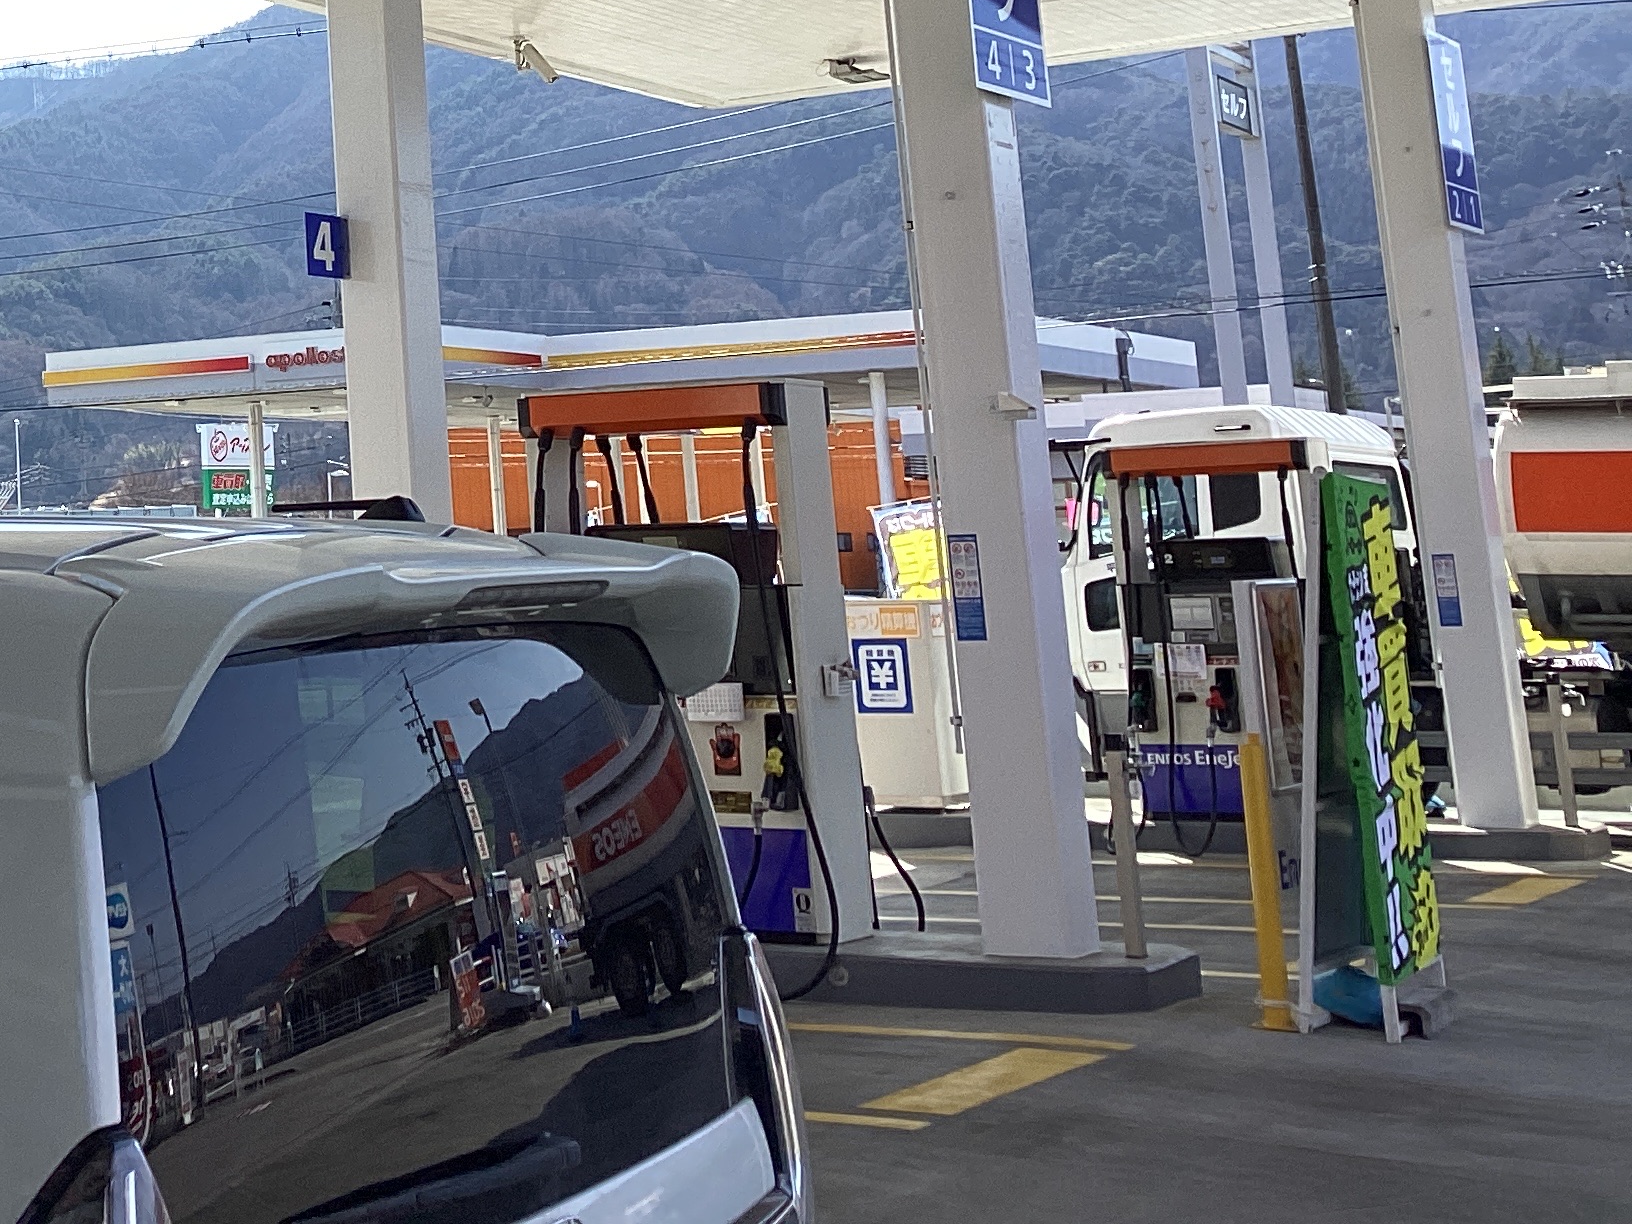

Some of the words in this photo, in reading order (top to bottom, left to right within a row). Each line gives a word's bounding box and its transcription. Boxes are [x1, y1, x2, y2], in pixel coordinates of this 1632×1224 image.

[985, 42, 1003, 82] 4
[1020, 49, 1039, 94] 3
[1220, 87, 1247, 120] セルフ
[1440, 46, 1464, 177] セルフ
[1452, 190, 1462, 220] 2
[1470, 195, 1476, 224] 1
[312, 221, 336, 272] 4
